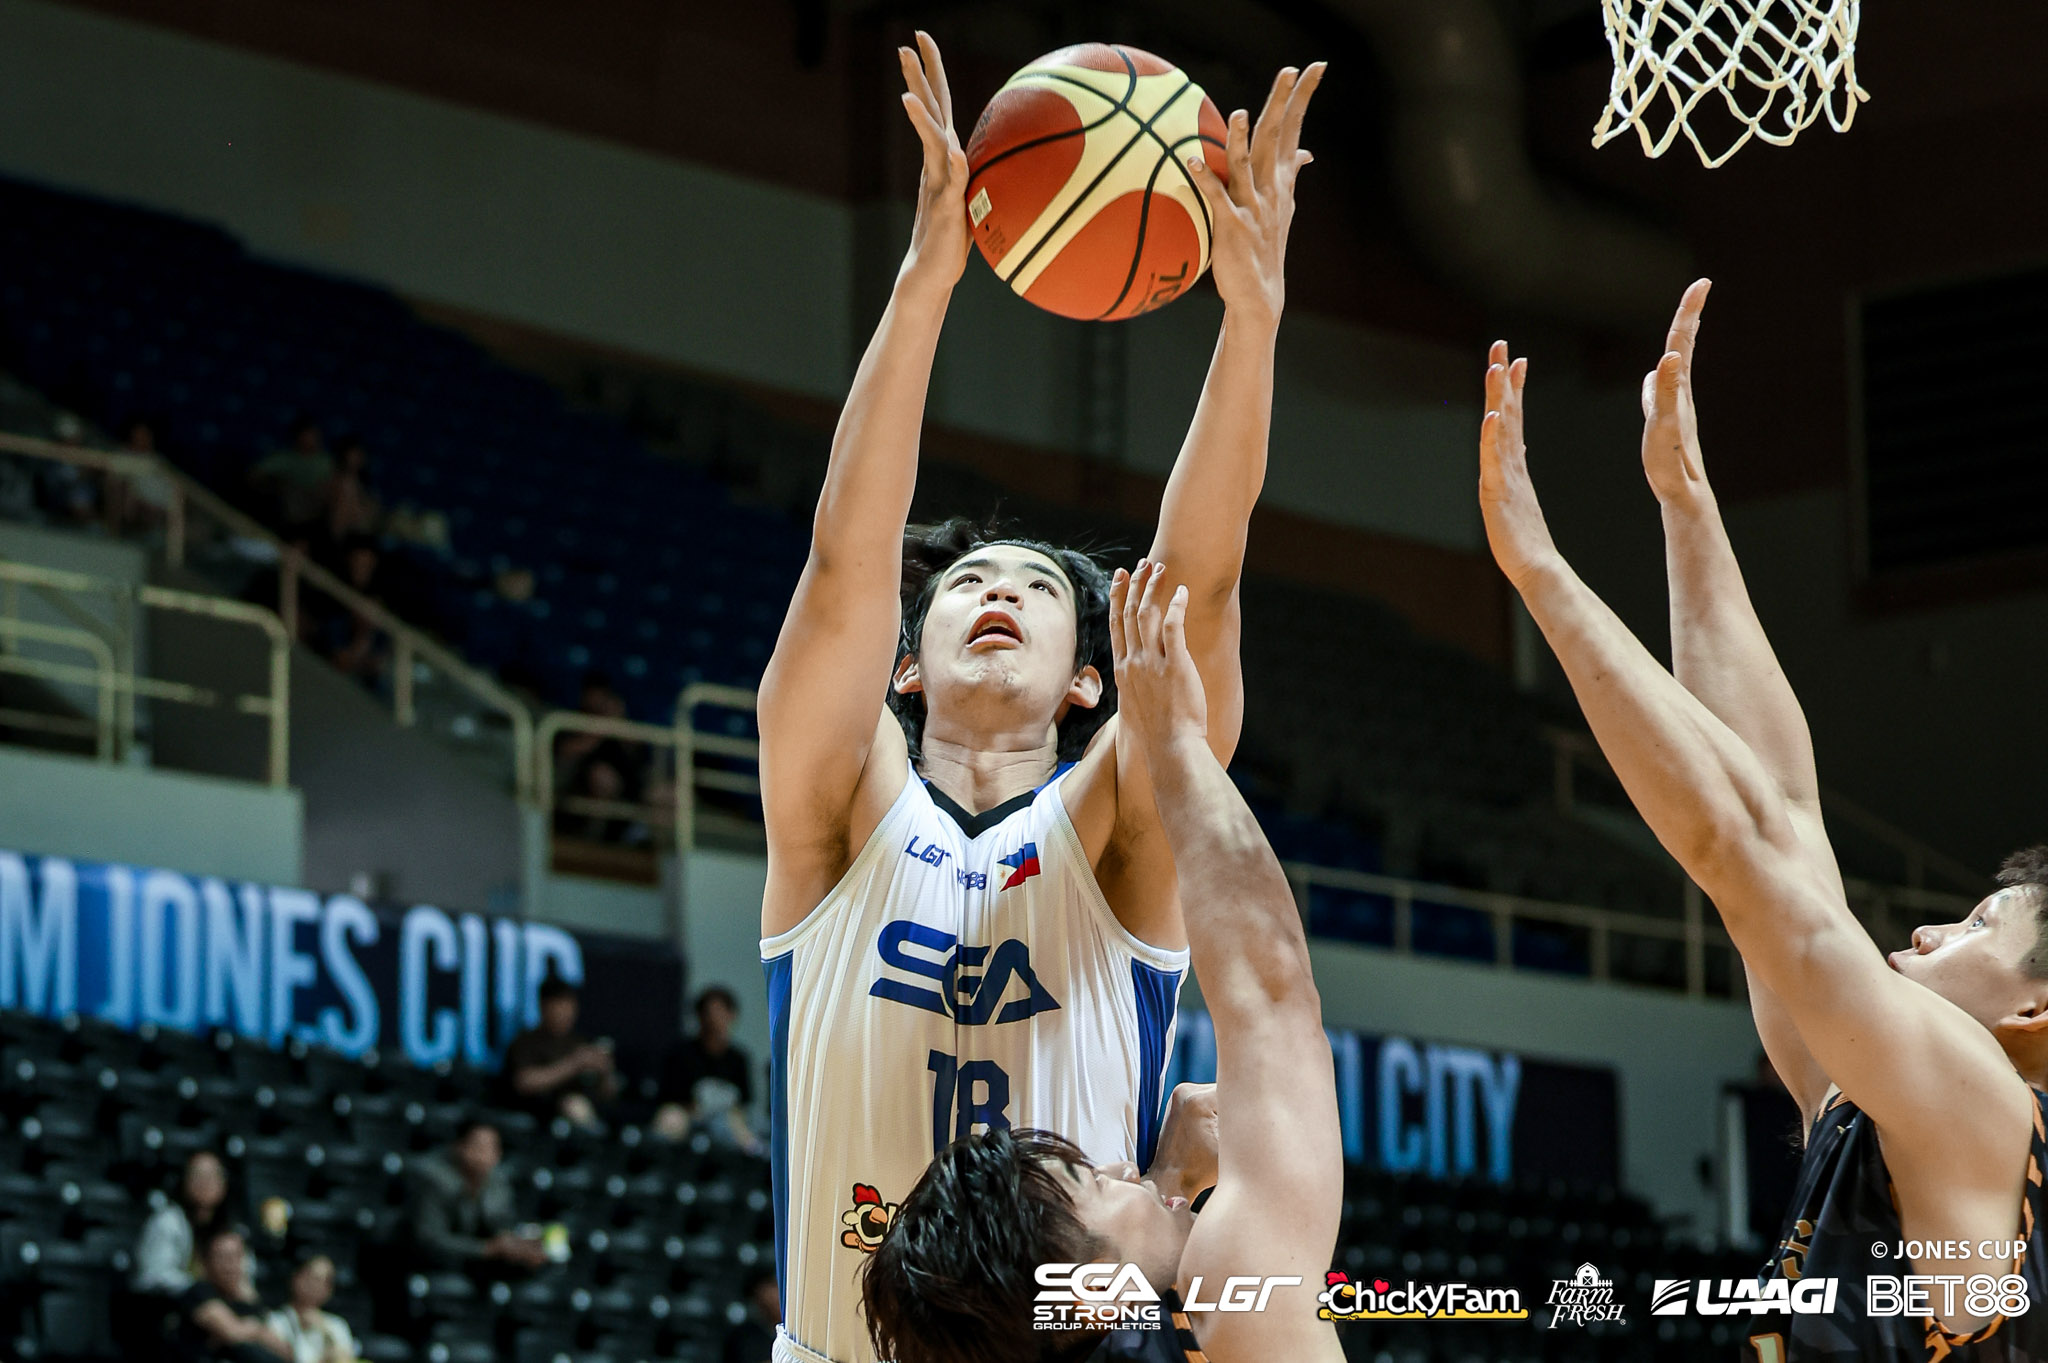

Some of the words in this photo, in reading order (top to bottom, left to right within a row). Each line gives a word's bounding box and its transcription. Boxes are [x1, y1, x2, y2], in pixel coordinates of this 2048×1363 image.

[98, 864, 379, 1056] JONES
[869, 919, 1061, 1025] SGA
[1379, 1037, 1521, 1182] CITY
